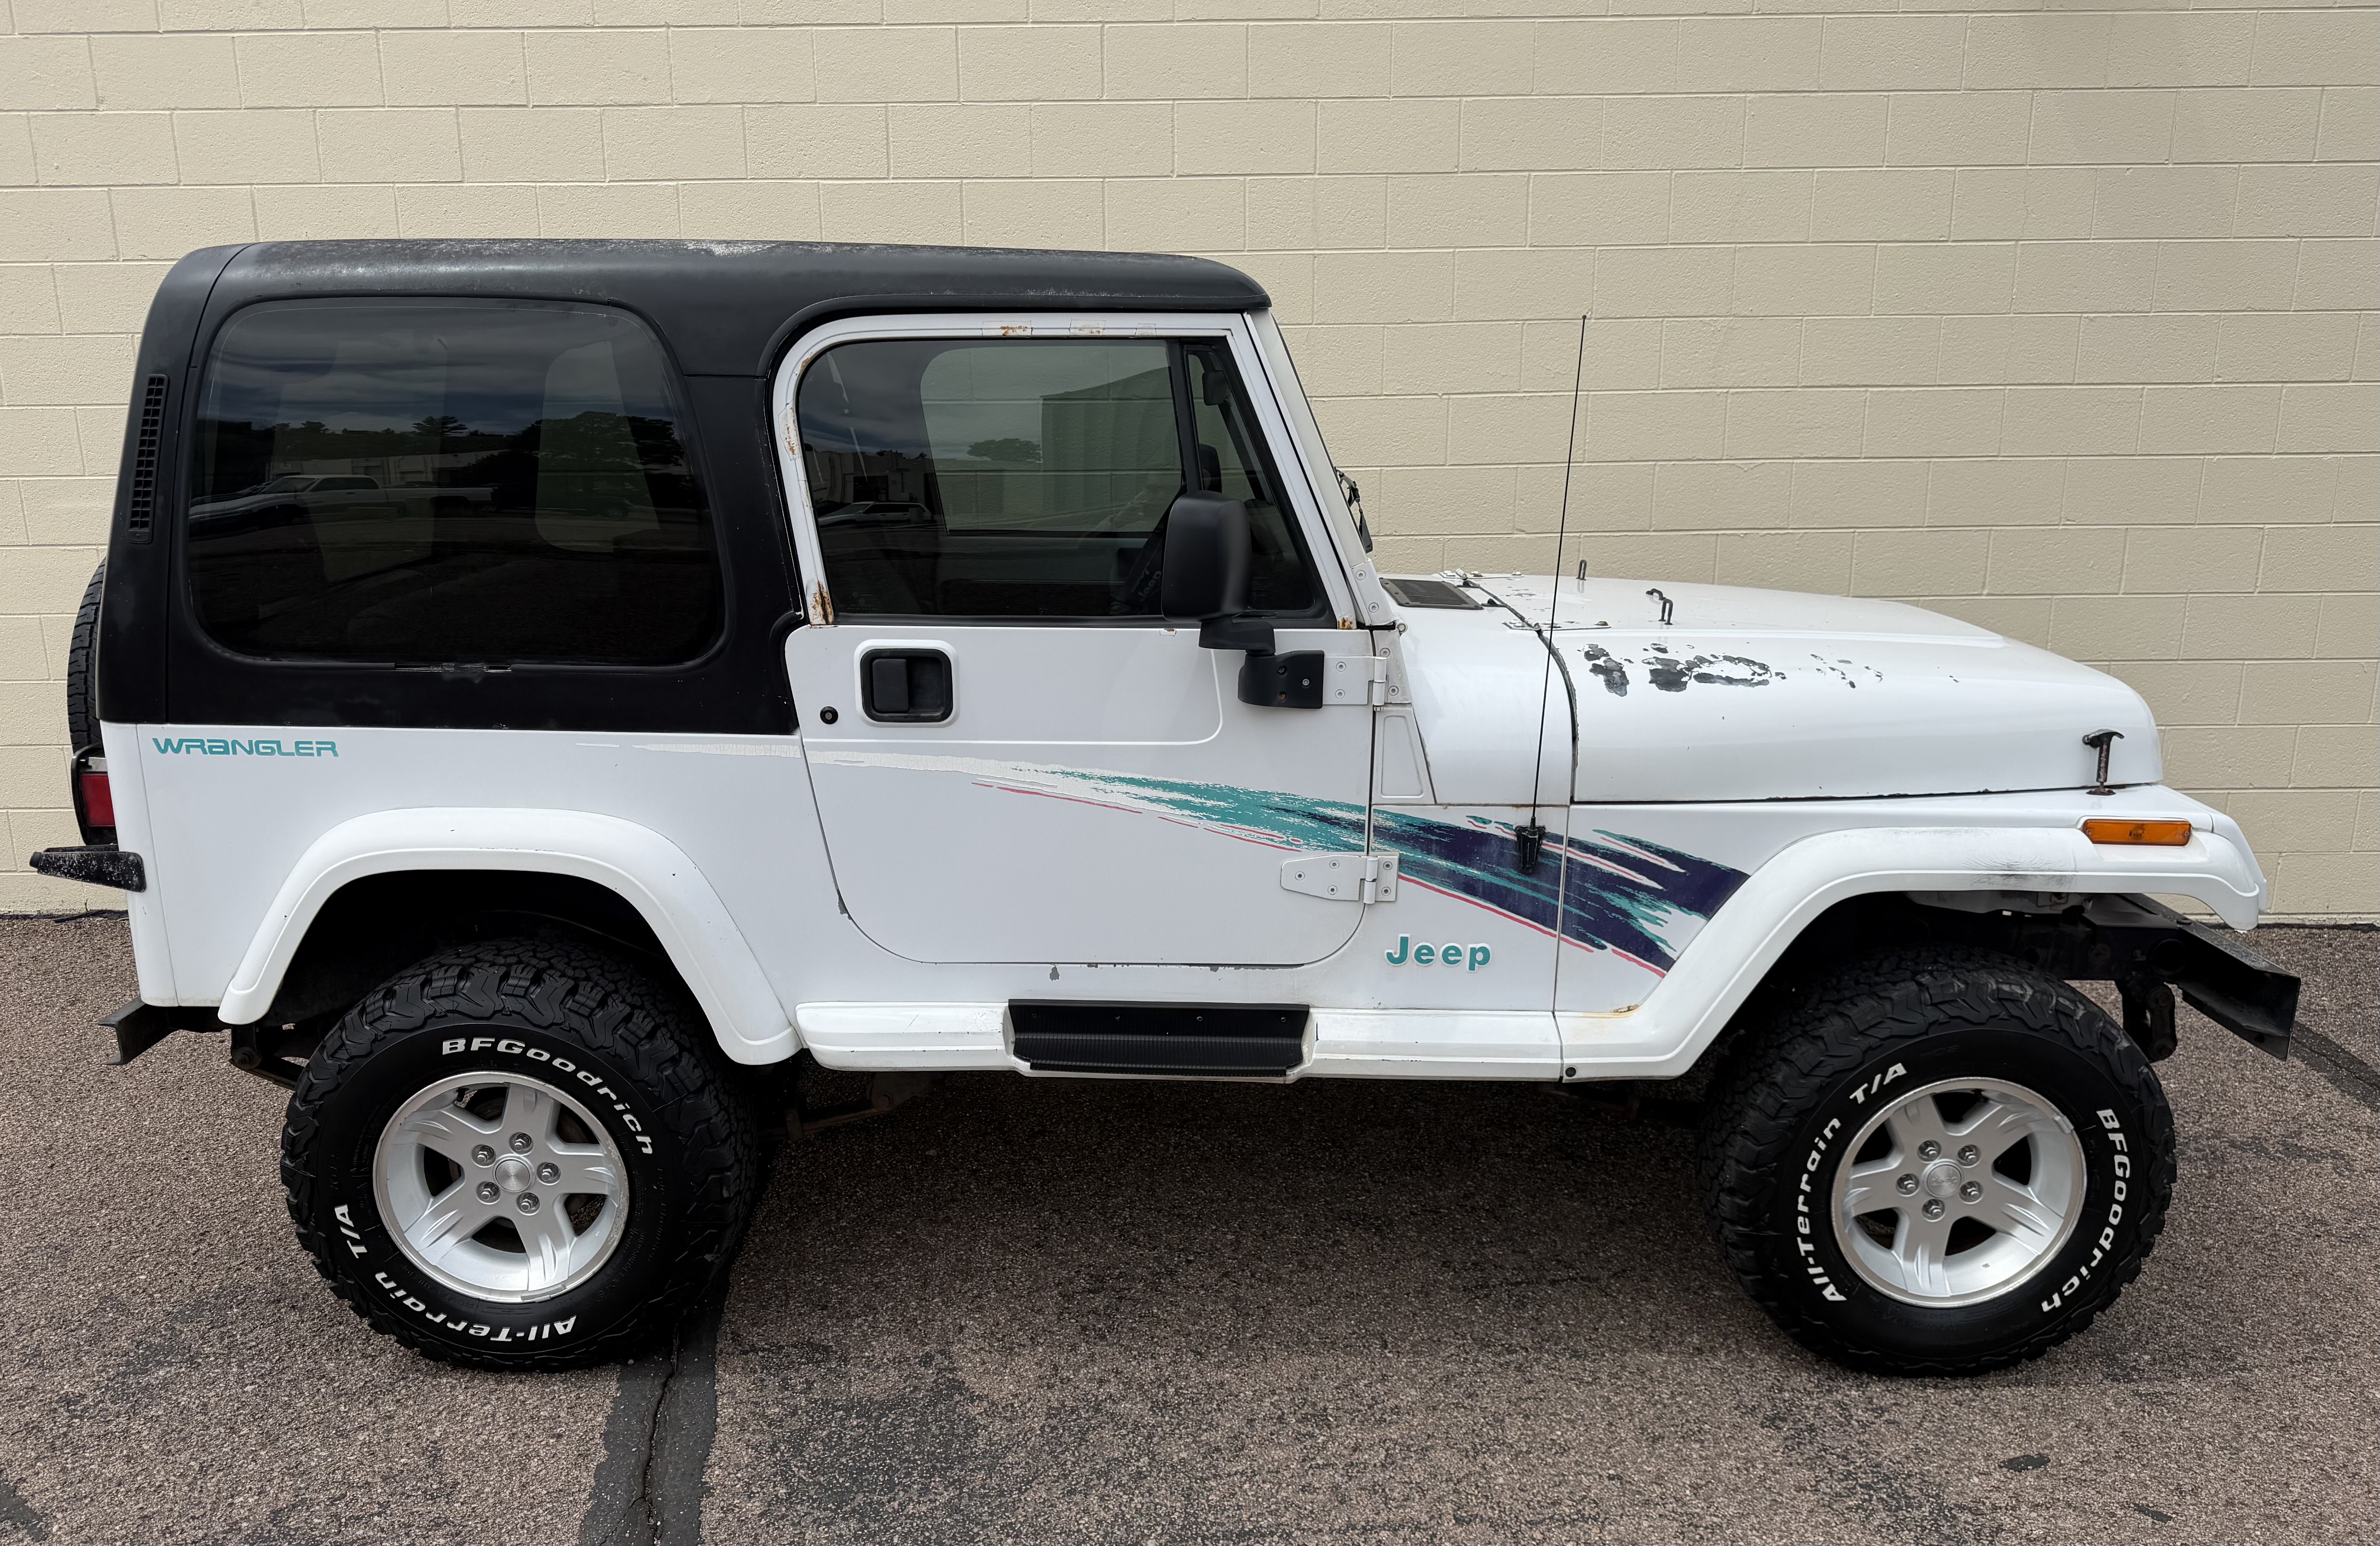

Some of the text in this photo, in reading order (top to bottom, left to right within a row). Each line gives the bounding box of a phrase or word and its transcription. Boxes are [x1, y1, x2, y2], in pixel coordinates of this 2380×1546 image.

[1386, 935, 1491, 971] Jeep
[442, 1037, 653, 1154] BFGoodrich
[1796, 1062, 1907, 1301] All-Terrain T/A
[2041, 1109, 2130, 1312] BFGoodrich
[334, 1204, 368, 1259] T/A
[374, 1271, 577, 1341] All-Terrain
